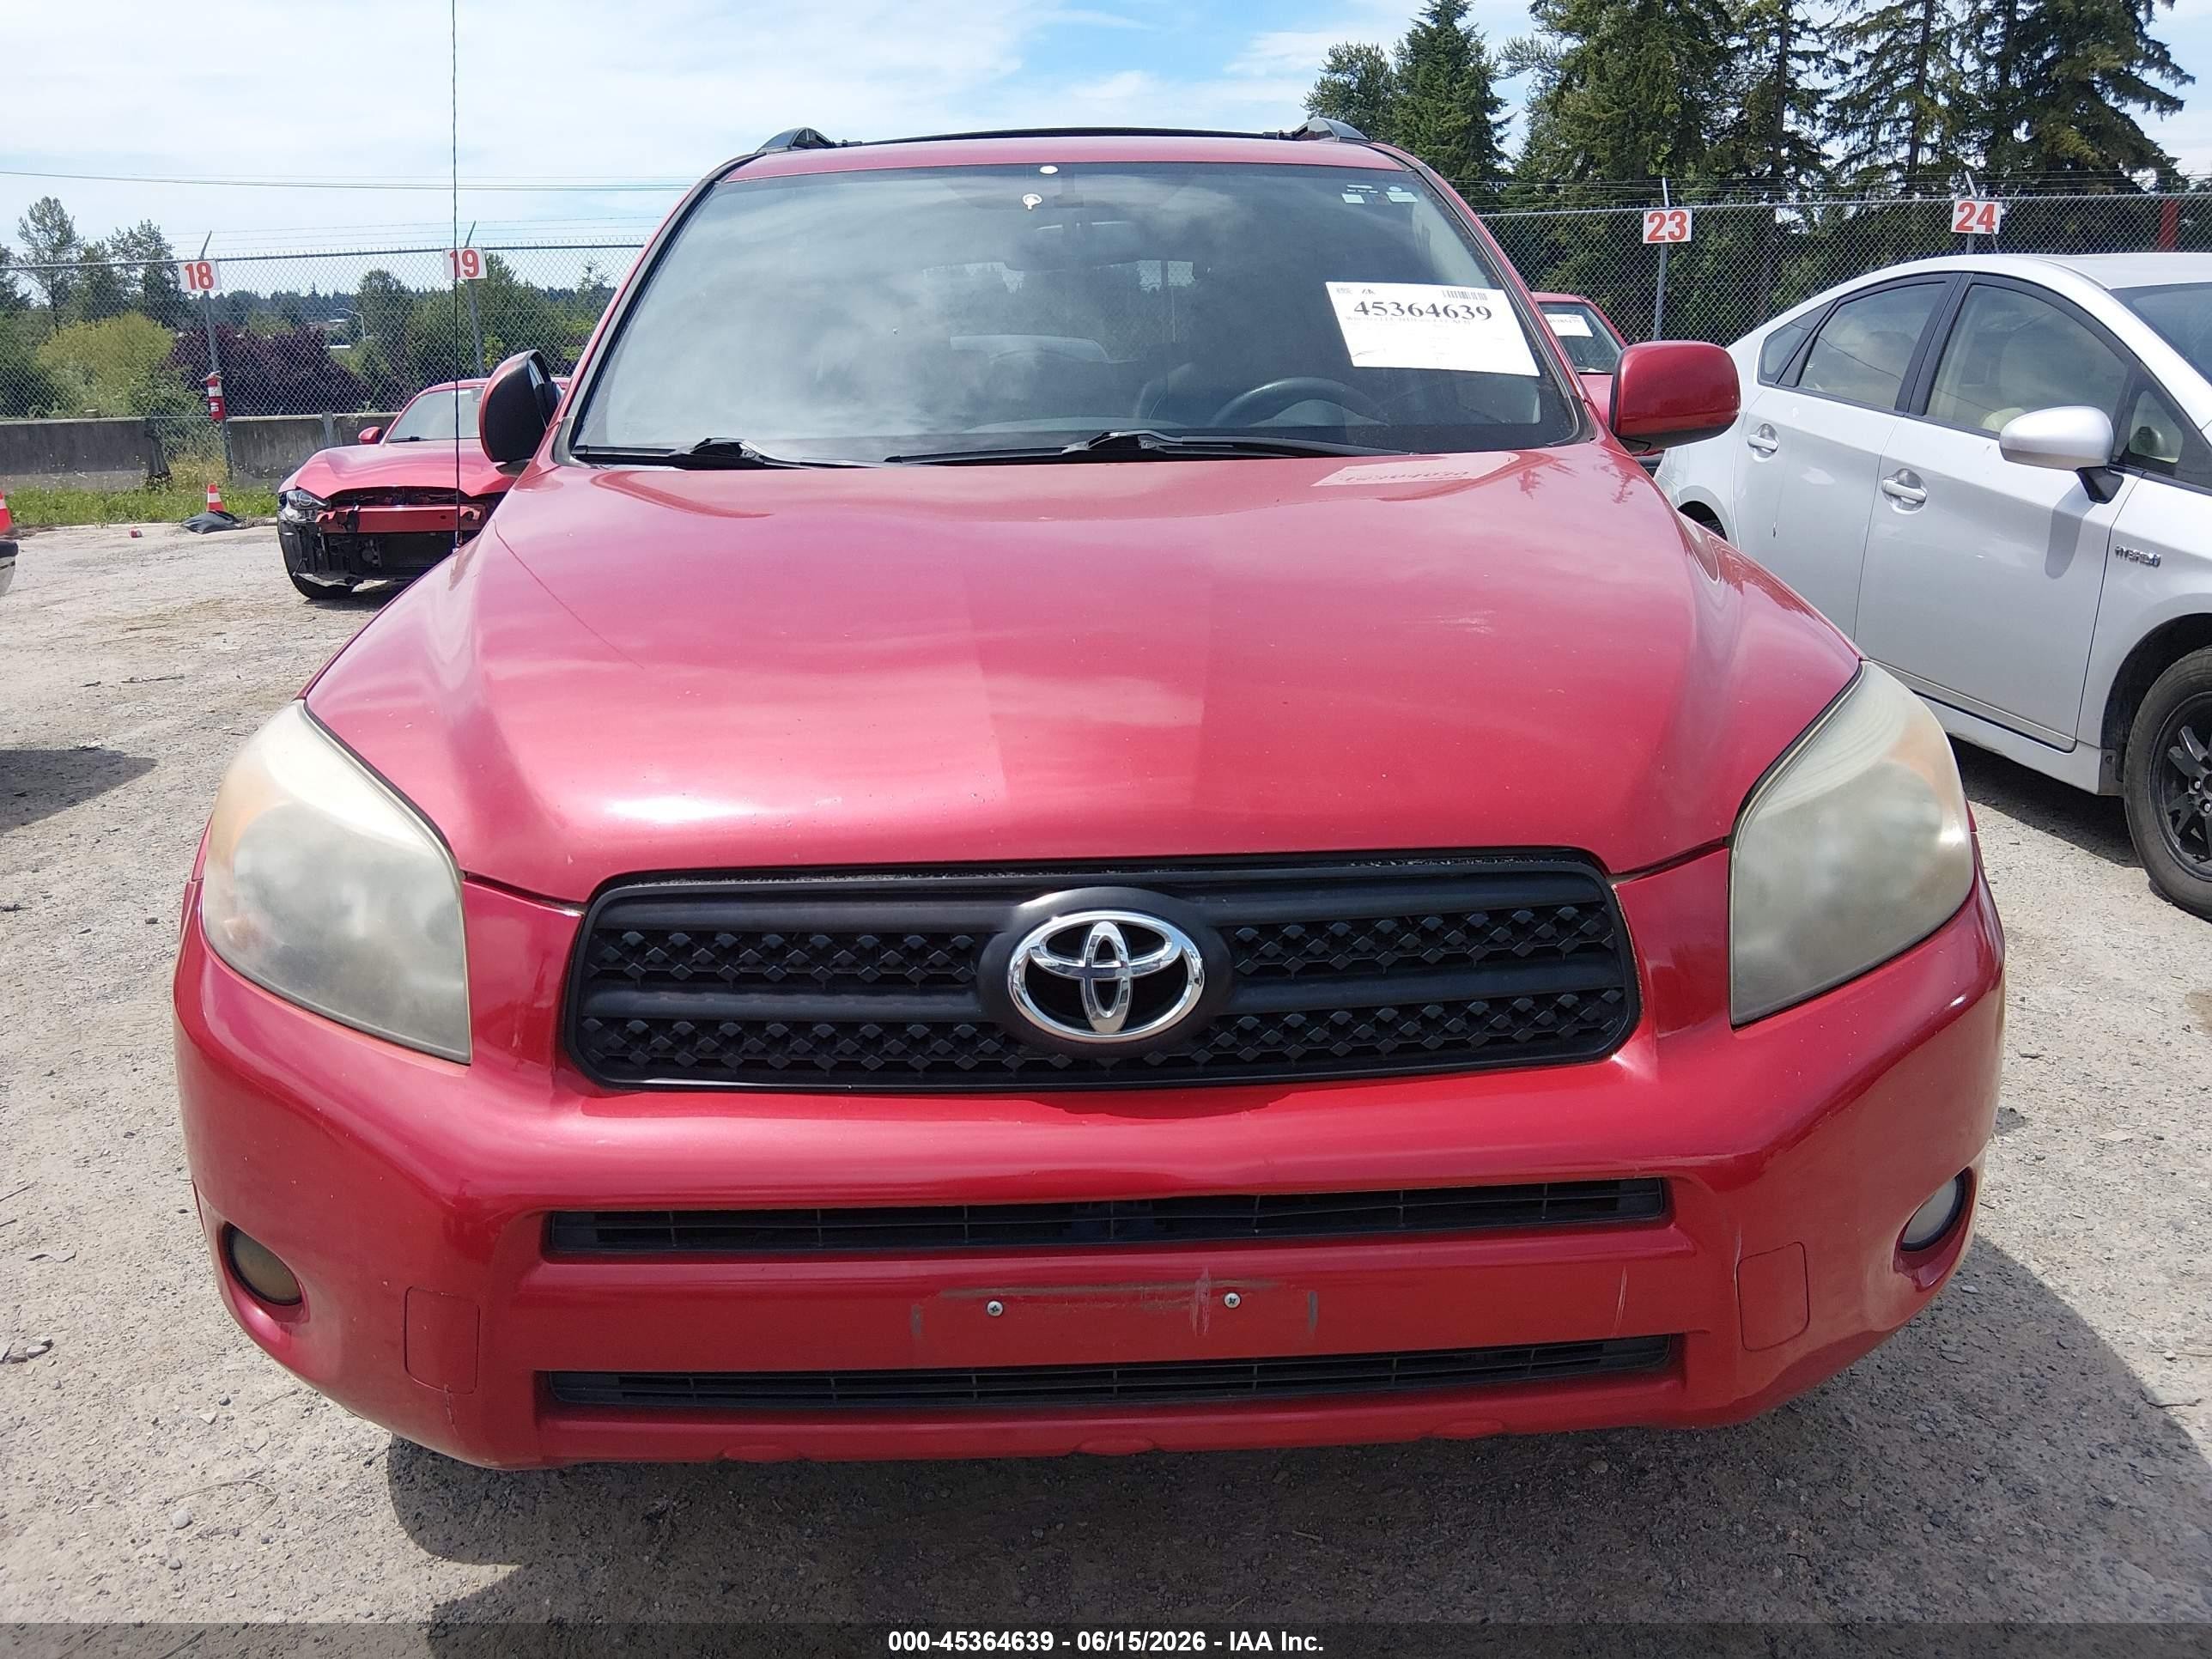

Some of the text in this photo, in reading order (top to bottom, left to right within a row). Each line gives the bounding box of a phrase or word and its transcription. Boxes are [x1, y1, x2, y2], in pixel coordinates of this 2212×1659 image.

[1647, 210, 1687, 241] 23
[1955, 202, 1996, 233] 24
[185, 261, 215, 290] 18
[449, 249, 480, 278] 19
[1353, 301, 1492, 321] 45364639
